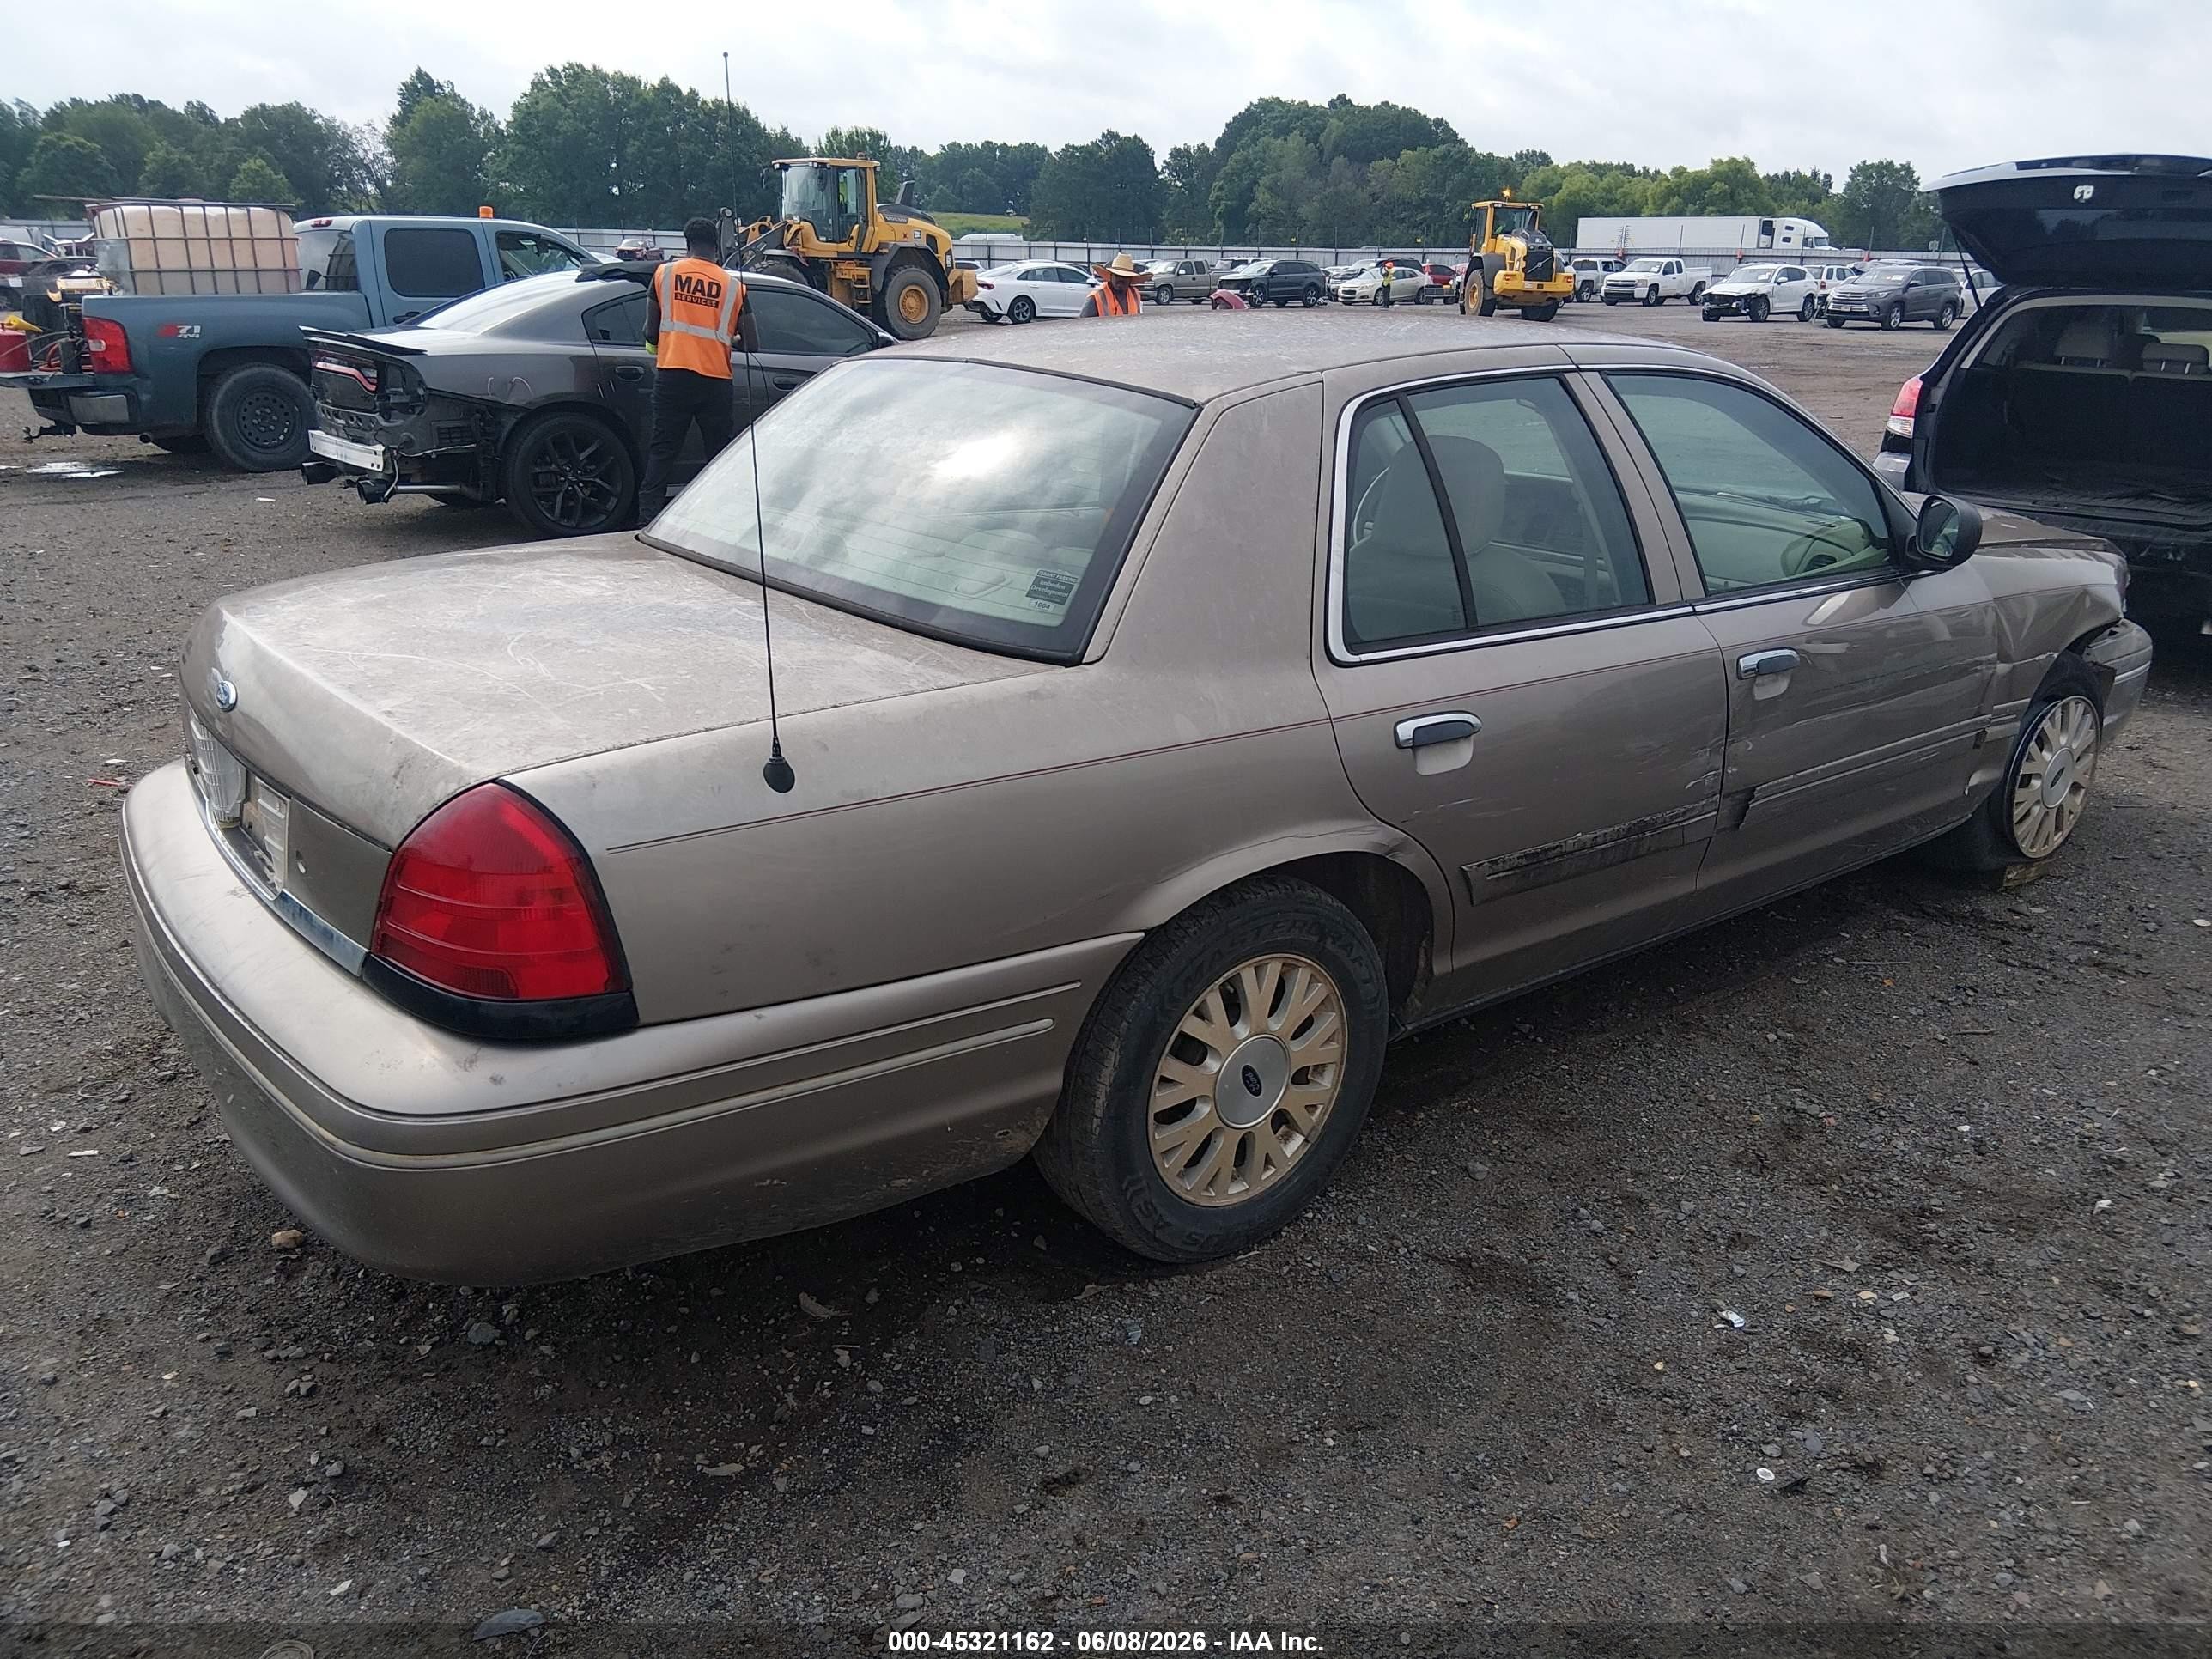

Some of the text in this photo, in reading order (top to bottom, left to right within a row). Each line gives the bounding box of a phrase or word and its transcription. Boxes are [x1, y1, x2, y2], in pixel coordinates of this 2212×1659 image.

[674, 274, 722, 299] MAD
[676, 293, 718, 307] SERVICES
[1034, 600, 1051, 610] 1004
